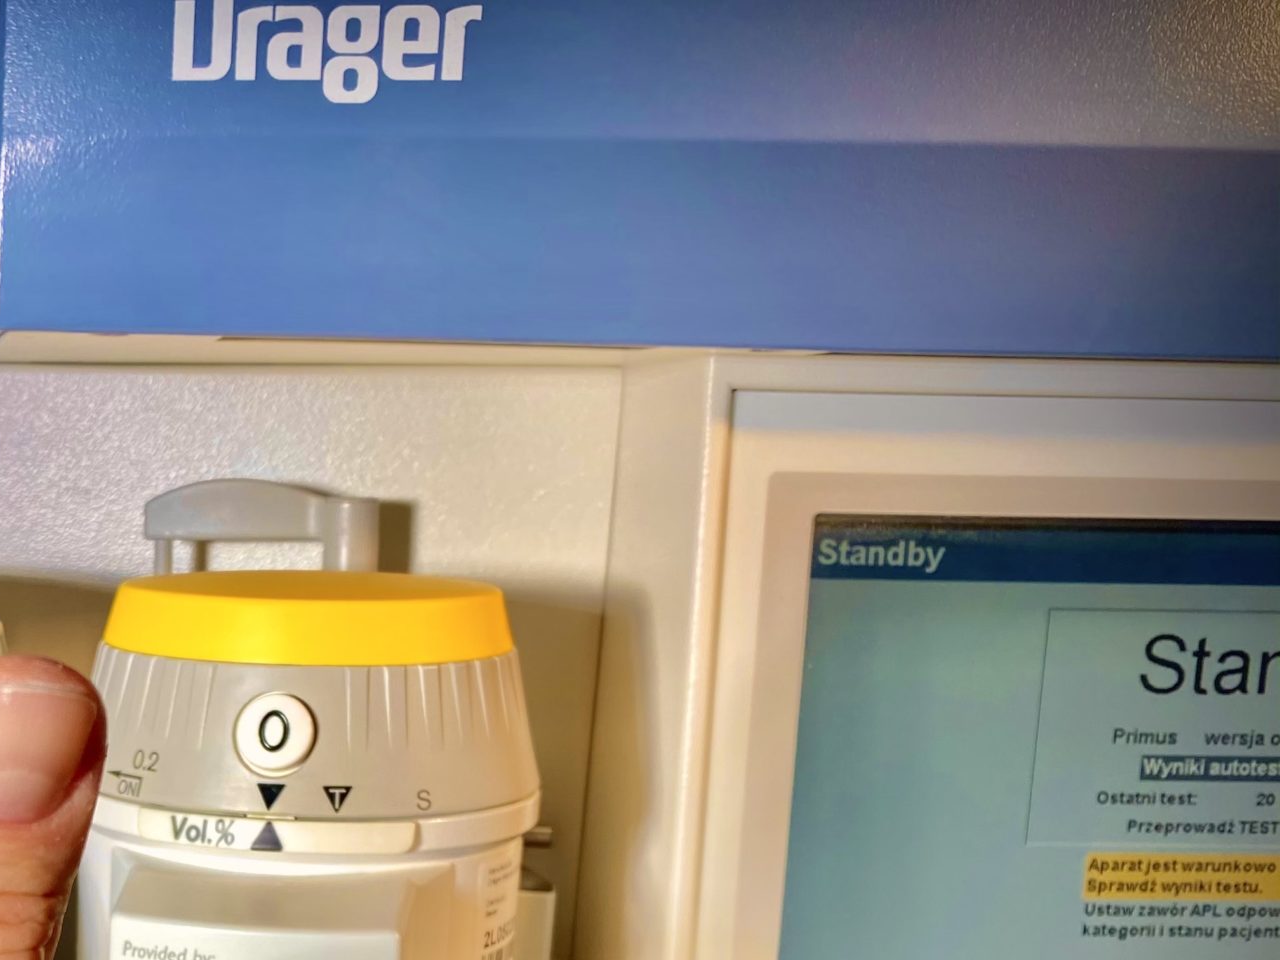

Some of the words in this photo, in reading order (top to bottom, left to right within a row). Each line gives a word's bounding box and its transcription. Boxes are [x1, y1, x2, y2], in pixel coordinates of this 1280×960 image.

[818, 539, 946, 574] Standby
[1113, 728, 1178, 746] Primus
[1205, 730, 1264, 749] wersja
[133, 750, 159, 772] 0.2
[1143, 758, 1205, 778] Wyniki
[117, 779, 140, 797] ON
[417, 789, 431, 811] S
[1096, 791, 1156, 805] Ostatni
[1088, 858, 1143, 875] Aparat
[1144, 859, 1177, 876] jest
[1182, 860, 1276, 873] warunkowo
[1161, 881, 1212, 896] wyniki
[1216, 881, 1263, 894] testu.
[1084, 903, 1133, 917] Ustaw
[1138, 903, 1187, 917] zawór
[1190, 904, 1221, 917] APL
[1082, 923, 1155, 941] kategorii
[1169, 925, 1214, 938] stanu
